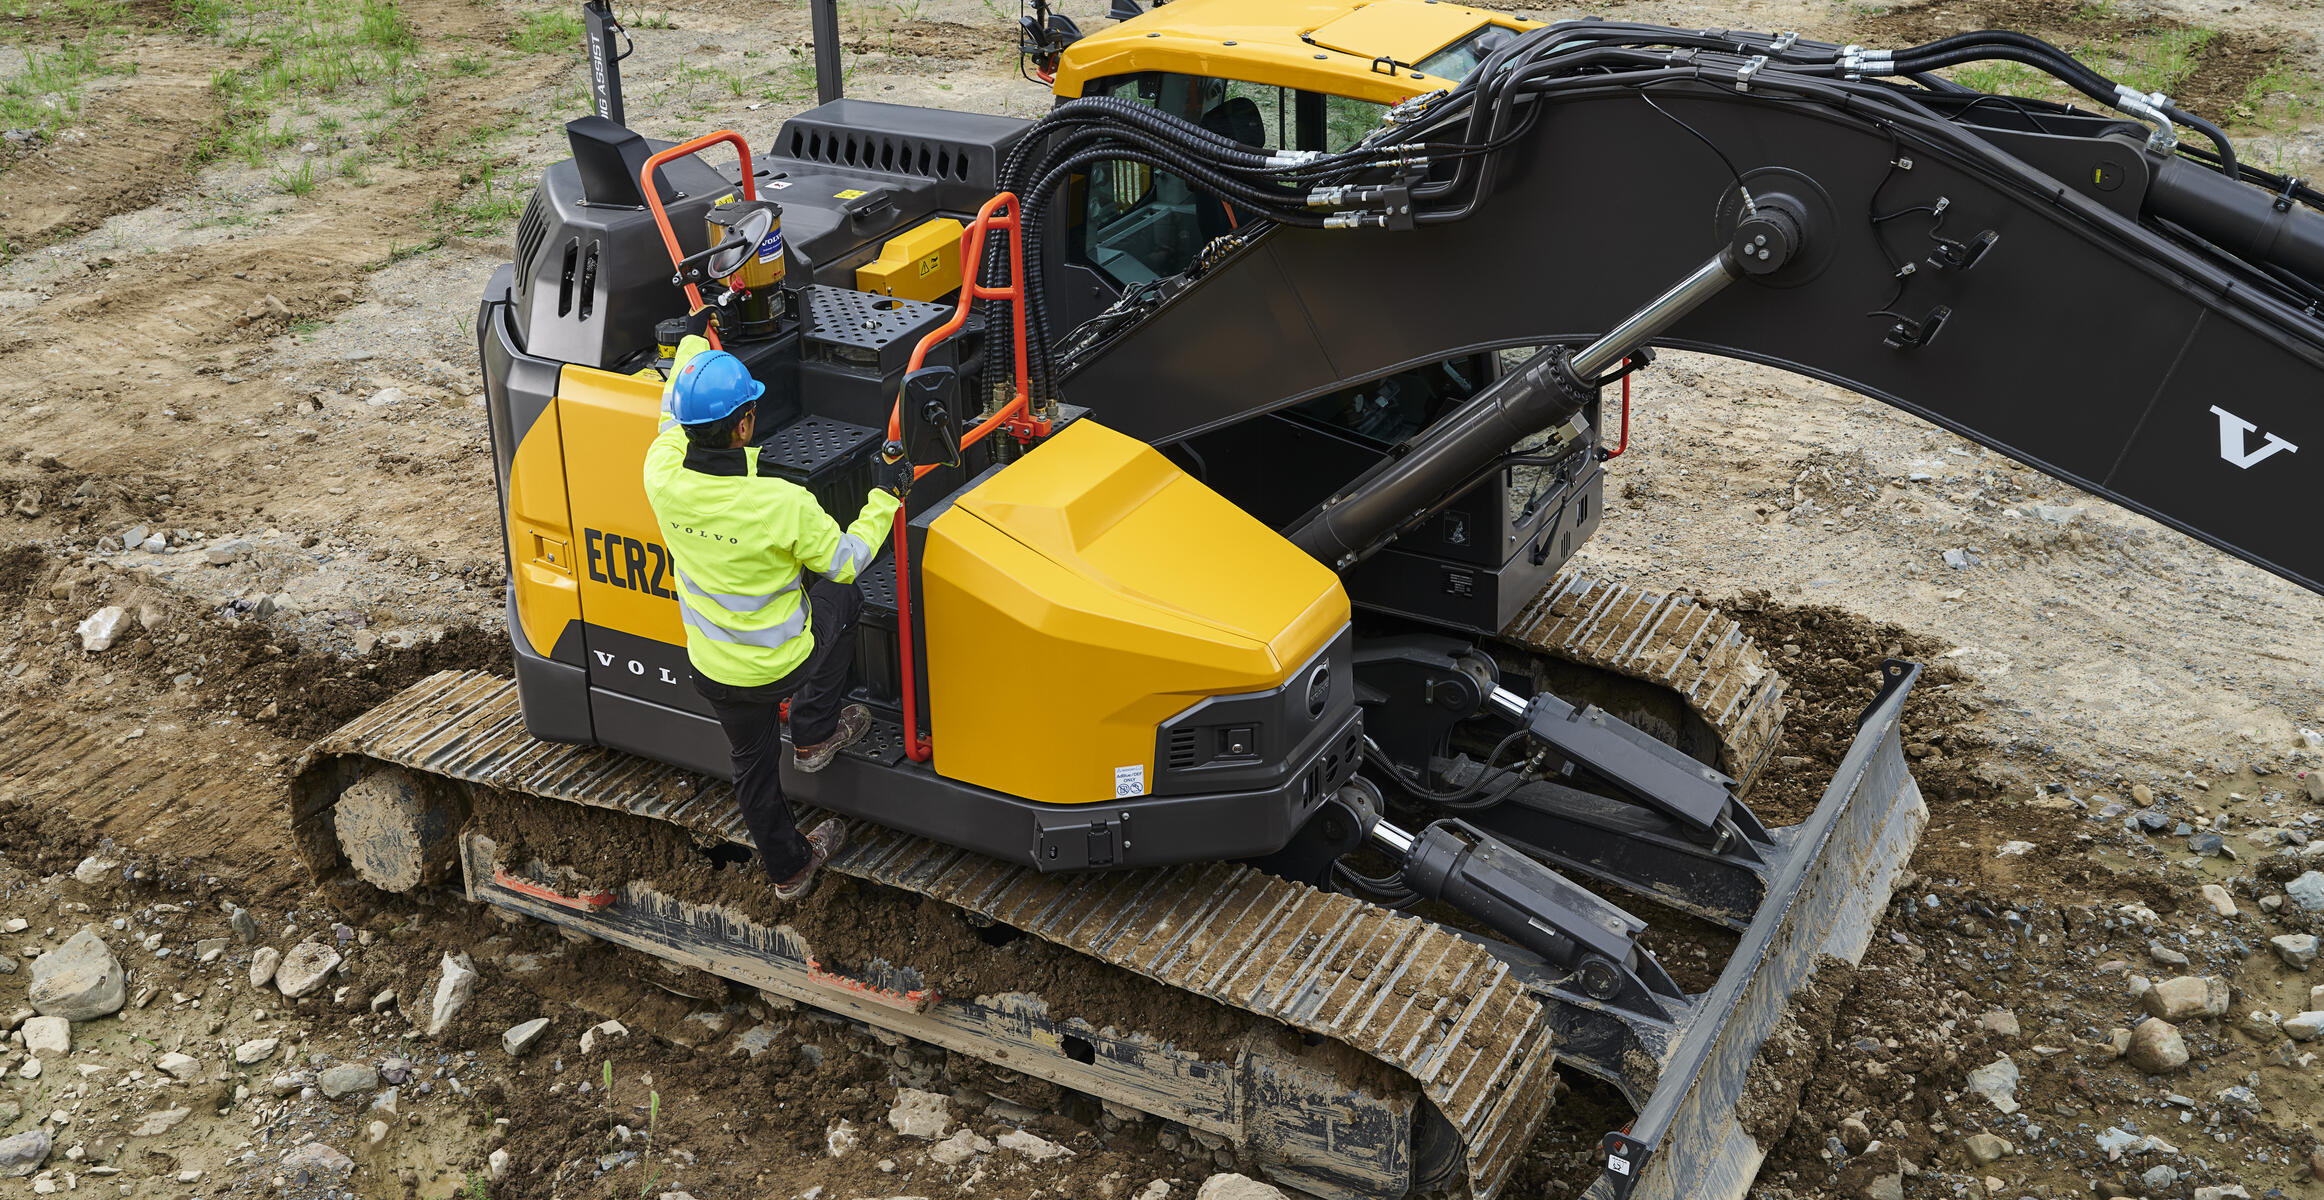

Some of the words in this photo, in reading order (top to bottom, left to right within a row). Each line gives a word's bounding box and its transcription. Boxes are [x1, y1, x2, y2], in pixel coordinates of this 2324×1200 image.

[591, 32, 607, 96] ASSIST
[2209, 404, 2299, 470] V
[670, 521, 738, 545] VOLVO
[593, 649, 693, 685] VOL
